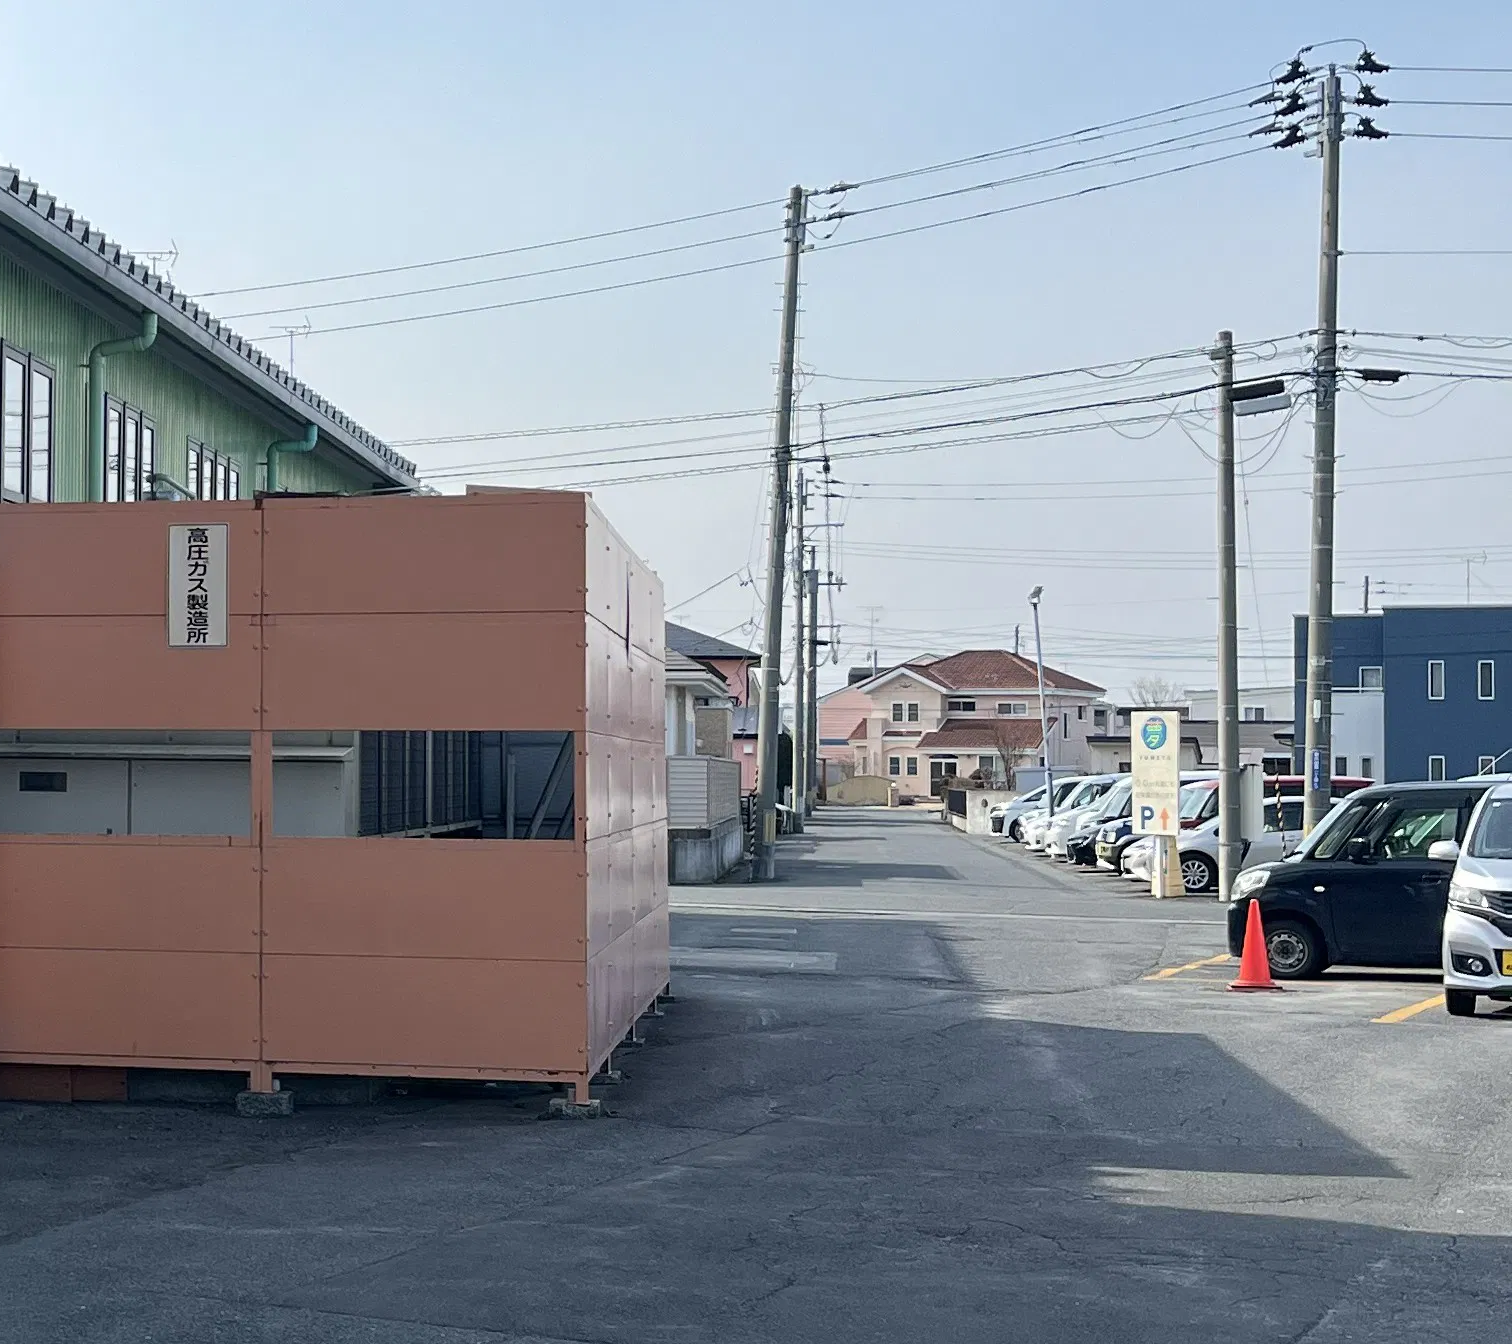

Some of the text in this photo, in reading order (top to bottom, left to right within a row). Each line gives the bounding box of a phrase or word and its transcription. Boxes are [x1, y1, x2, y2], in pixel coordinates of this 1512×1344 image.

[187, 527, 209, 644] 高圧ガス製造所
[1141, 806, 1154, 830] P
